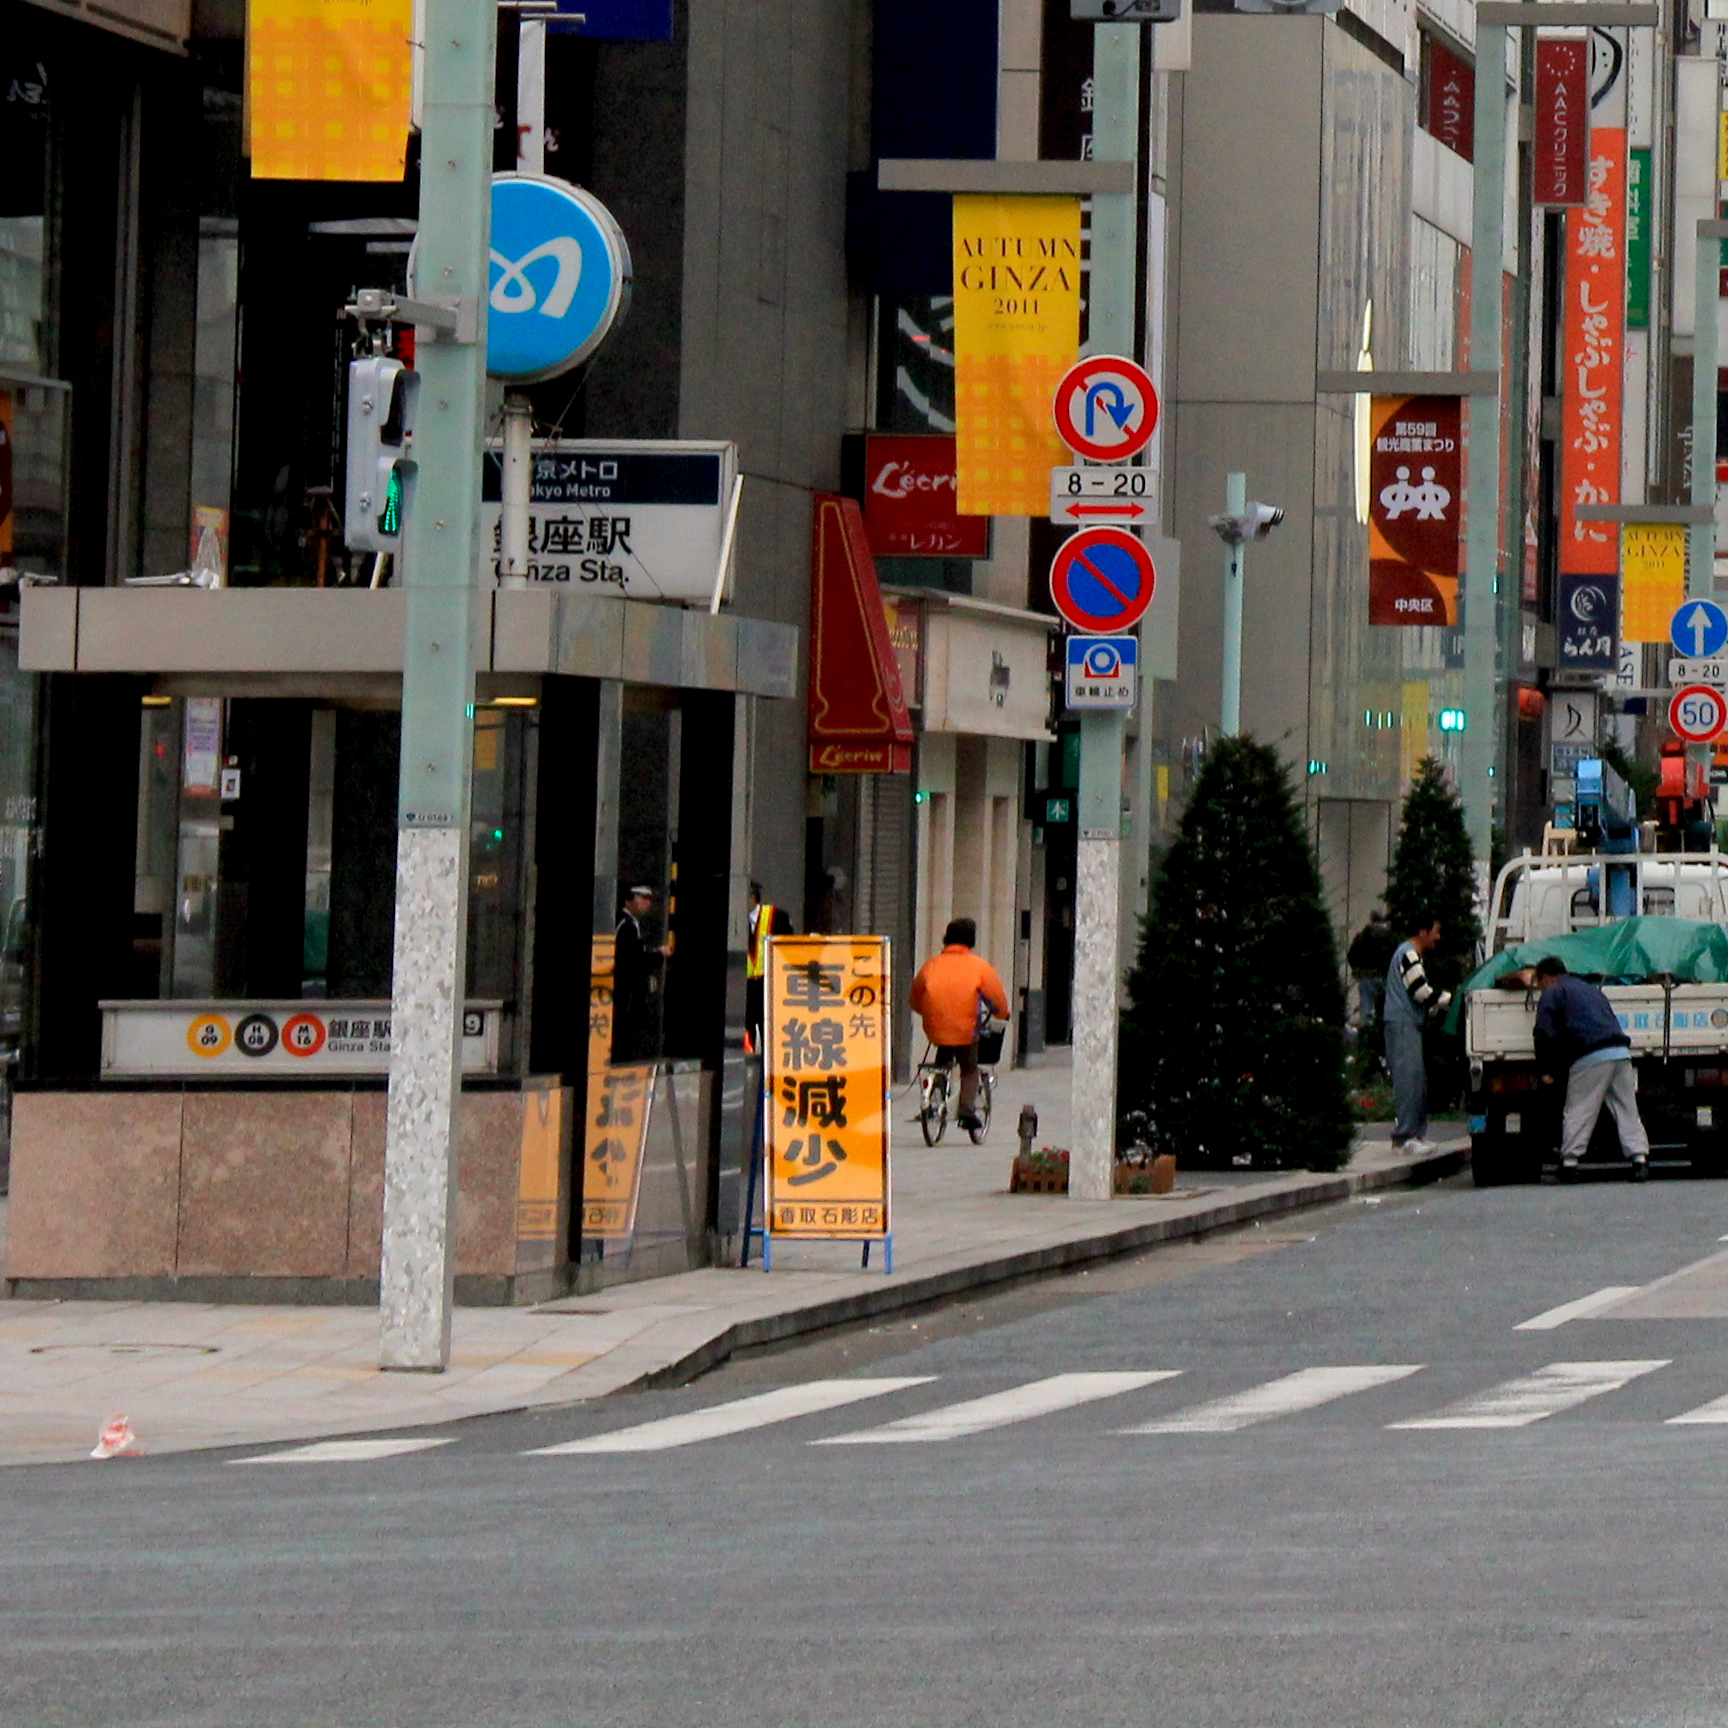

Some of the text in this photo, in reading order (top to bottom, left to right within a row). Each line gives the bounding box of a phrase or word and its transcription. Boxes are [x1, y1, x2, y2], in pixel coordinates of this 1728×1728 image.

[957, 237, 1079, 258] AUTUMN
[960, 265, 1073, 292] GINZA
[993, 298, 1042, 317] 2011
[1395, 421, 1437, 437] 第59回
[535, 460, 619, 481] 京メトロ
[566, 483, 611, 498] Metro
[1627, 544, 1681, 557] GINZA
[579, 558, 630, 583] Sta.
[1395, 598, 1434, 614] 中央区
[1074, 685, 1130, 698] 車輪止め
[1682, 700, 1714, 726] 50
[849, 955, 876, 1039] この先
[327, 1040, 365, 1053] Ginza
[781, 960, 847, 1187] 車線減少
[779, 1205, 880, 1225] 香取石彫店
